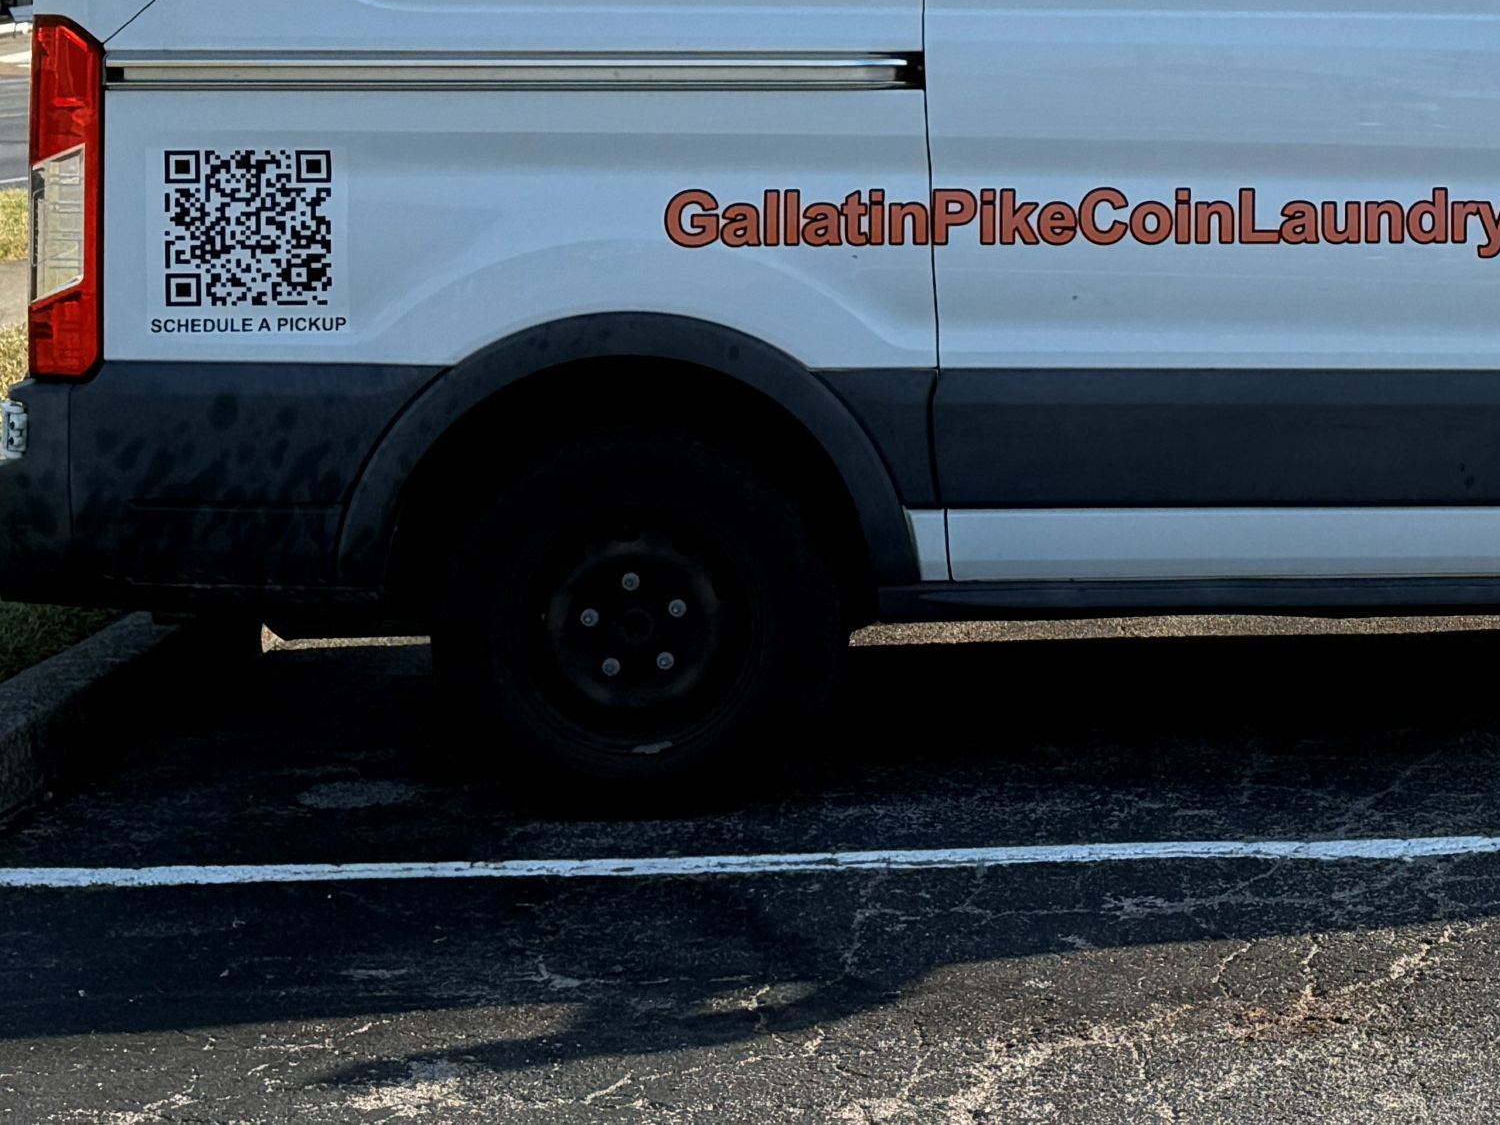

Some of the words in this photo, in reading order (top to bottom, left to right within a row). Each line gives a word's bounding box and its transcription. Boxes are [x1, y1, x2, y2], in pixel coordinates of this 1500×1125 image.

[150, 316, 254, 335] SCHEDULE
[258, 316, 272, 334] A
[277, 316, 348, 334] PICKUP
